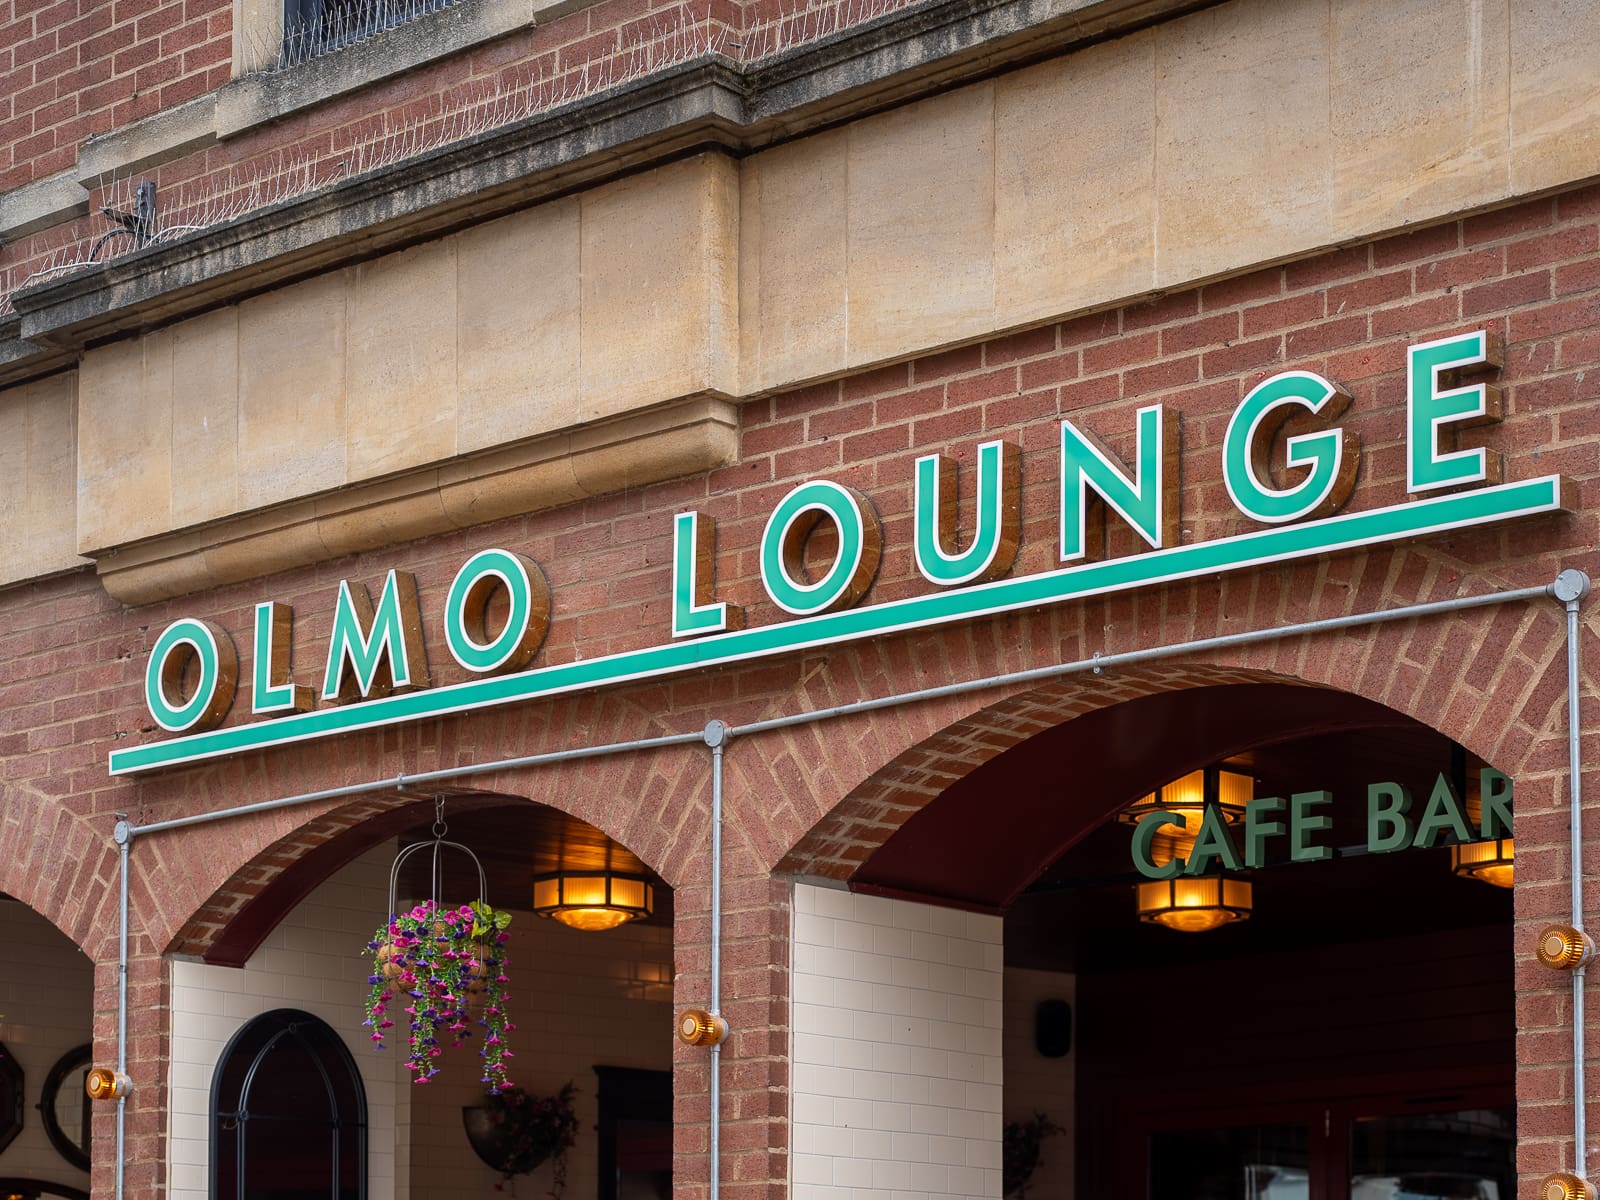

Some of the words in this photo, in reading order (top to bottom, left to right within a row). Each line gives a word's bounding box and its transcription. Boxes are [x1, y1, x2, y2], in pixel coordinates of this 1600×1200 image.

[145, 548, 540, 733] OLMO
[672, 329, 1492, 638] LOUNGE
[1131, 790, 1332, 879] CAFE
[1368, 767, 1513, 853] BAR
